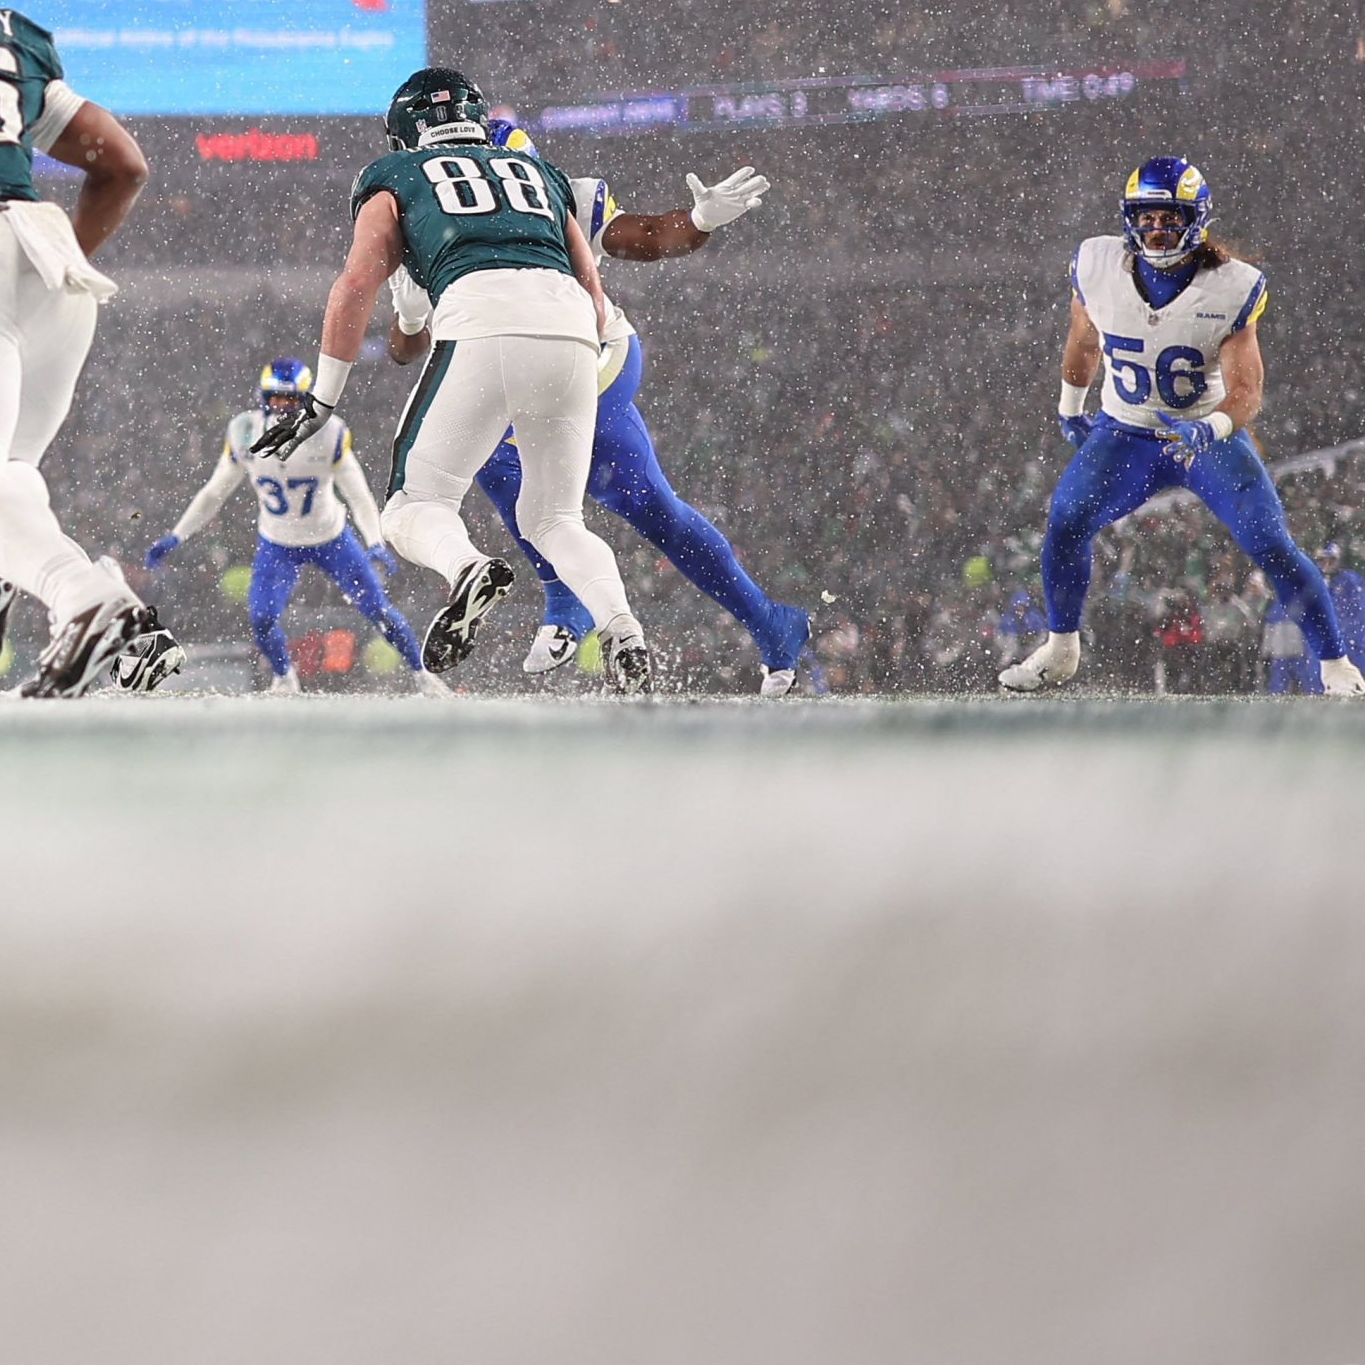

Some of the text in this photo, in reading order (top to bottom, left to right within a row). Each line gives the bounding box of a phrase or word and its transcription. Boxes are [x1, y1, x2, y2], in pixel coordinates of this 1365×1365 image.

[196, 127, 317, 162] verizon
[430, 126, 476, 138] CHOOSE LOVE
[422, 156, 555, 222] 88
[1196, 312, 1226, 320] RAMS
[1102, 333, 1207, 409] 56
[256, 477, 318, 518] 37
